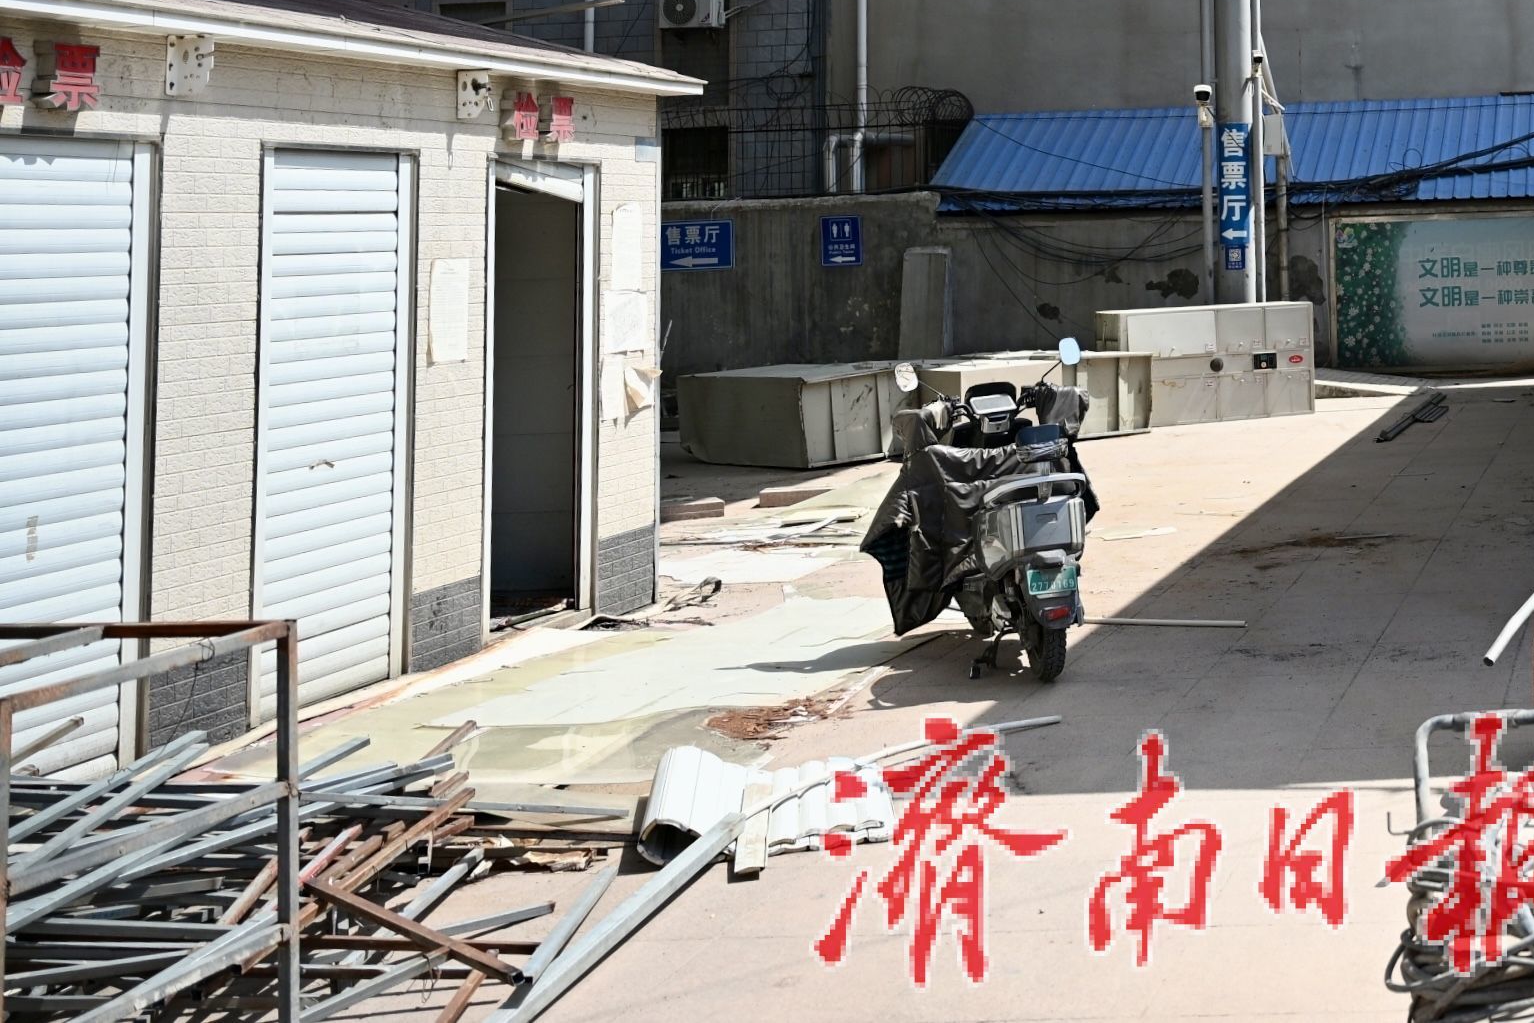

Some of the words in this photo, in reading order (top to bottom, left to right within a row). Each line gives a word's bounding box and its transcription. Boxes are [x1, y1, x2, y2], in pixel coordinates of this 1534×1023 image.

[1220, 128, 1247, 222] 售票厅
[665, 225, 720, 246] 售票厅
[670, 246, 693, 255] Ticket
[694, 245, 717, 254] Office
